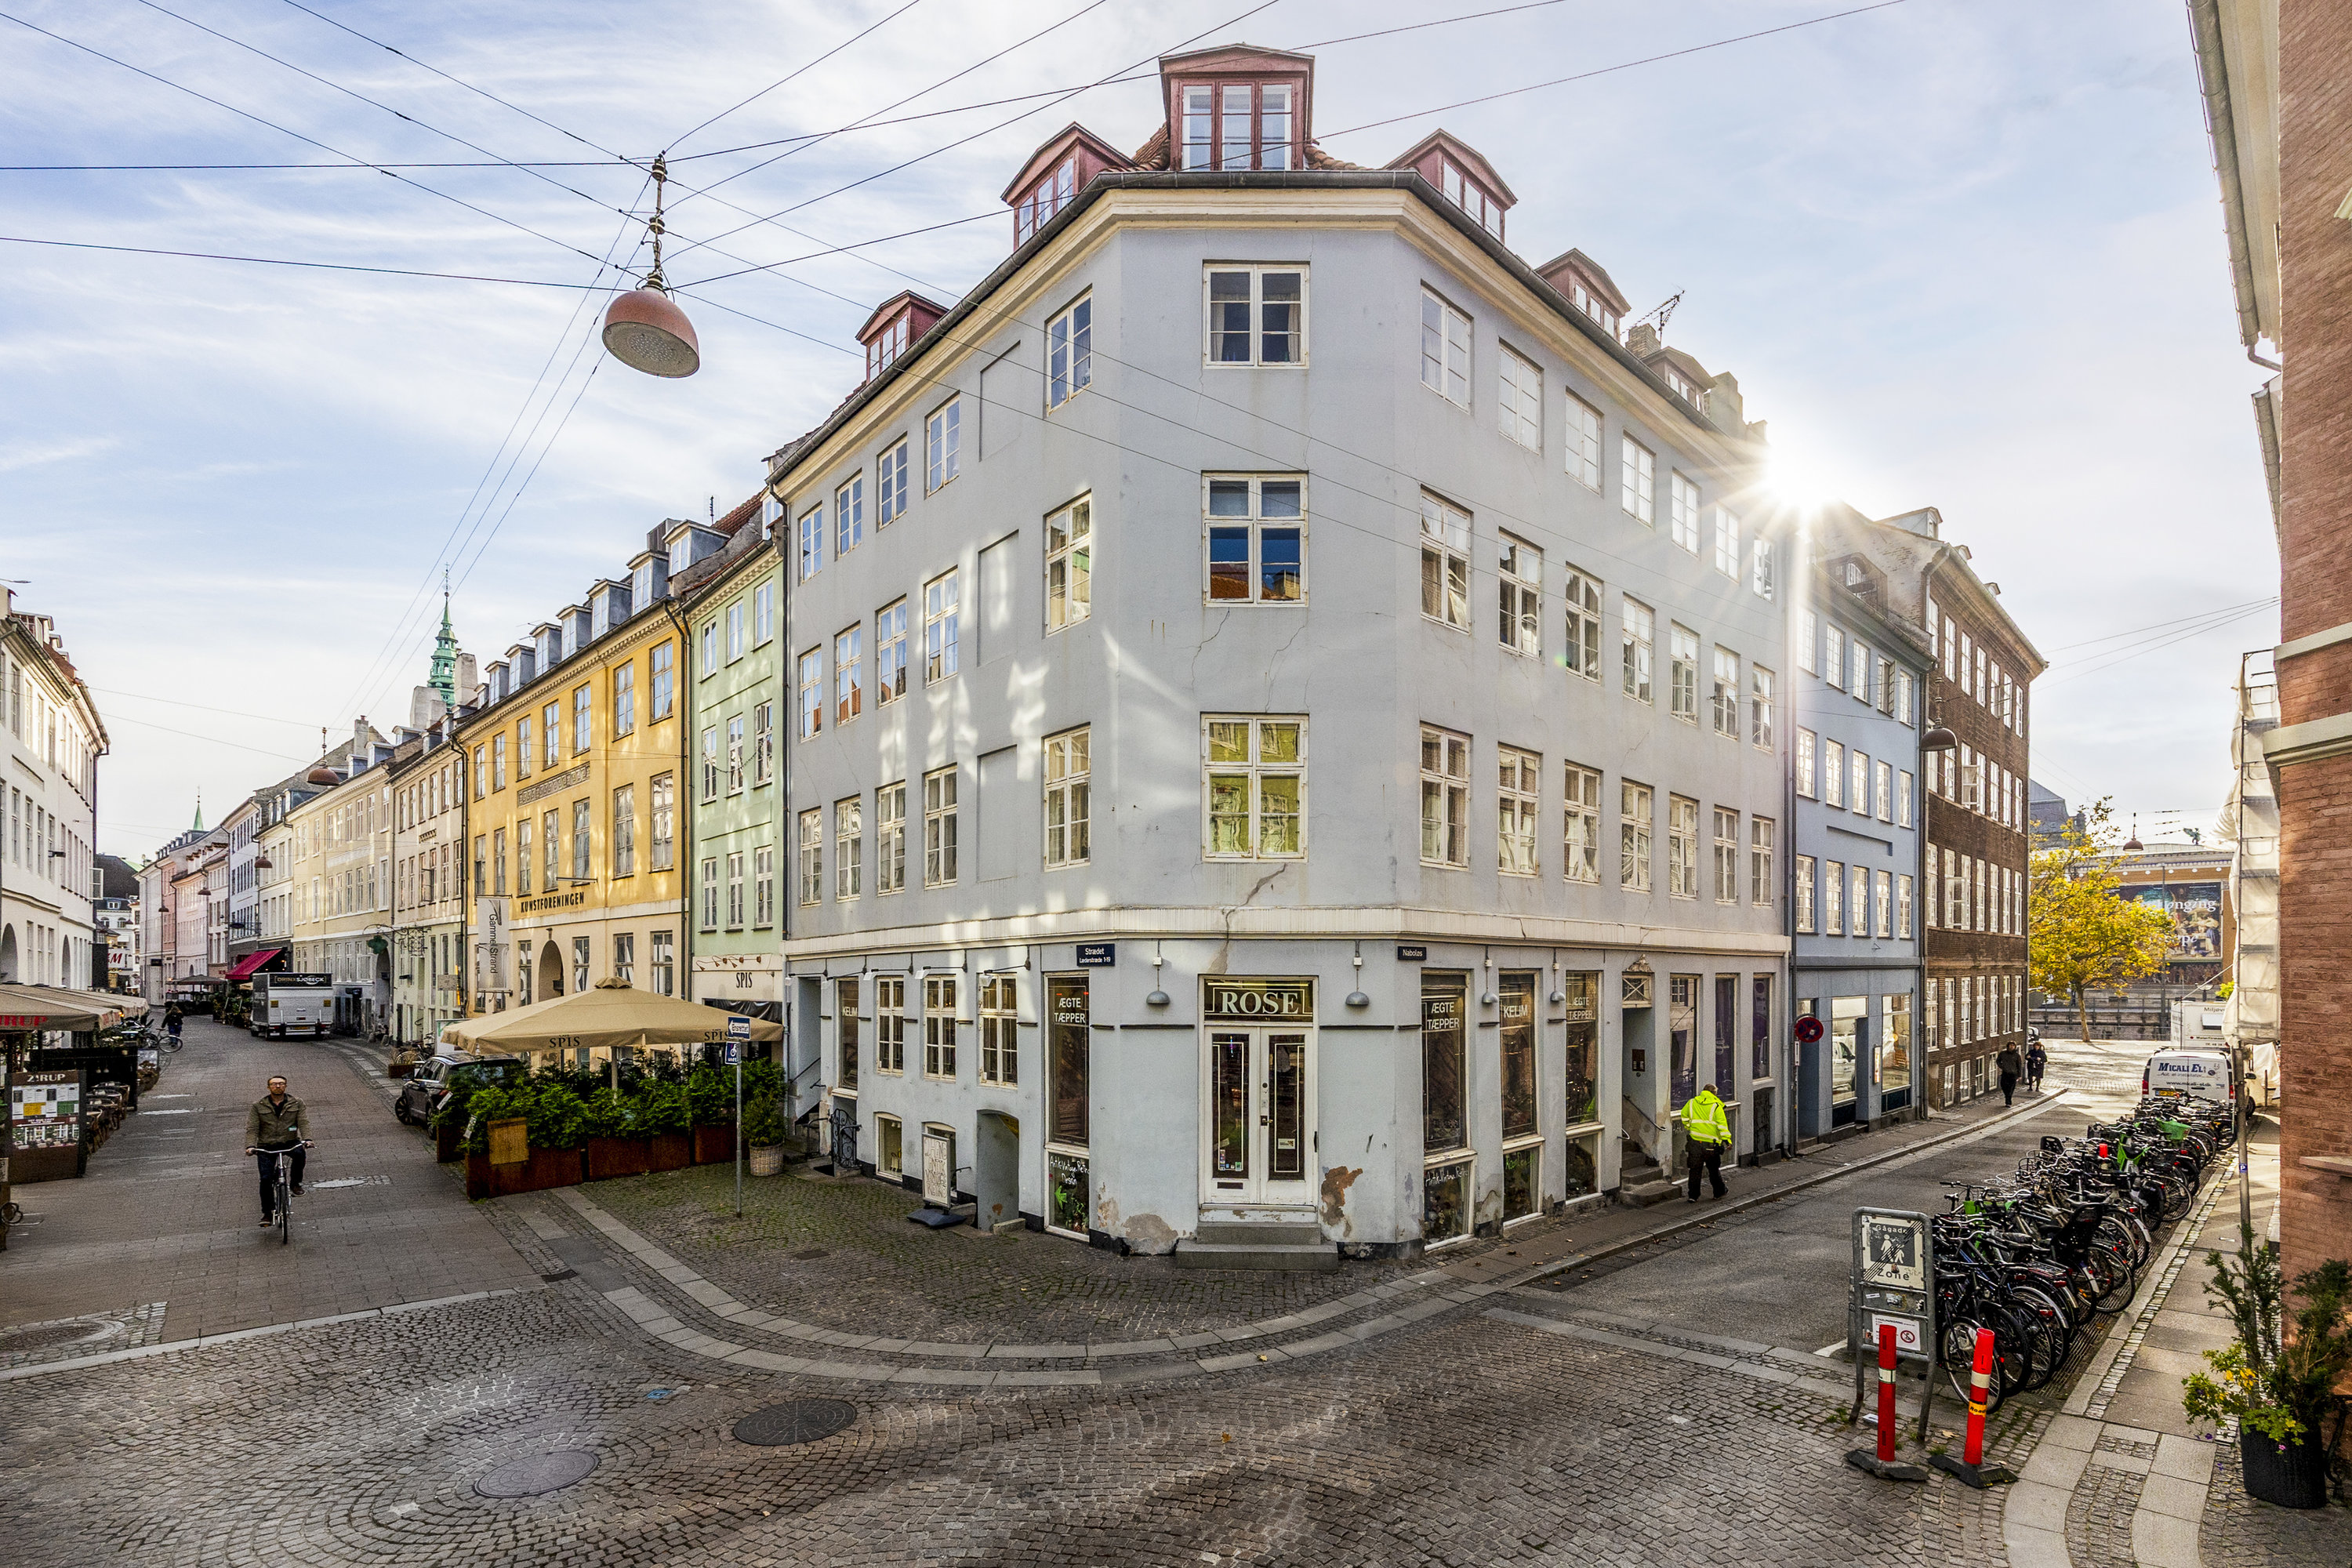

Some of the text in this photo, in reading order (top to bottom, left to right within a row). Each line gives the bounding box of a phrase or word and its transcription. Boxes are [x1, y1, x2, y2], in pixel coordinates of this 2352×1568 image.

[521, 891, 584, 913] KUNSTFORENINGEN
[488, 913, 499, 974] Gammel Strand
[735, 972, 753, 988] SPIS
[1058, 997, 1081, 1008] ÆGTE
[1219, 991, 1299, 1014] ROSE
[1573, 996, 1589, 1006] ÆGTE
[842, 1006, 858, 1017] KELIM
[1431, 1002, 1455, 1014] ÆGTE
[1503, 1004, 1528, 1018] KELIM
[0, 1014, 48, 1027] RUP
[1054, 1012, 1086, 1023] TÆPPER
[1569, 1010, 1593, 1019] TÆPPER
[1427, 1018, 1460, 1030] TÆPPER
[550, 1036, 581, 1048] SPIS
